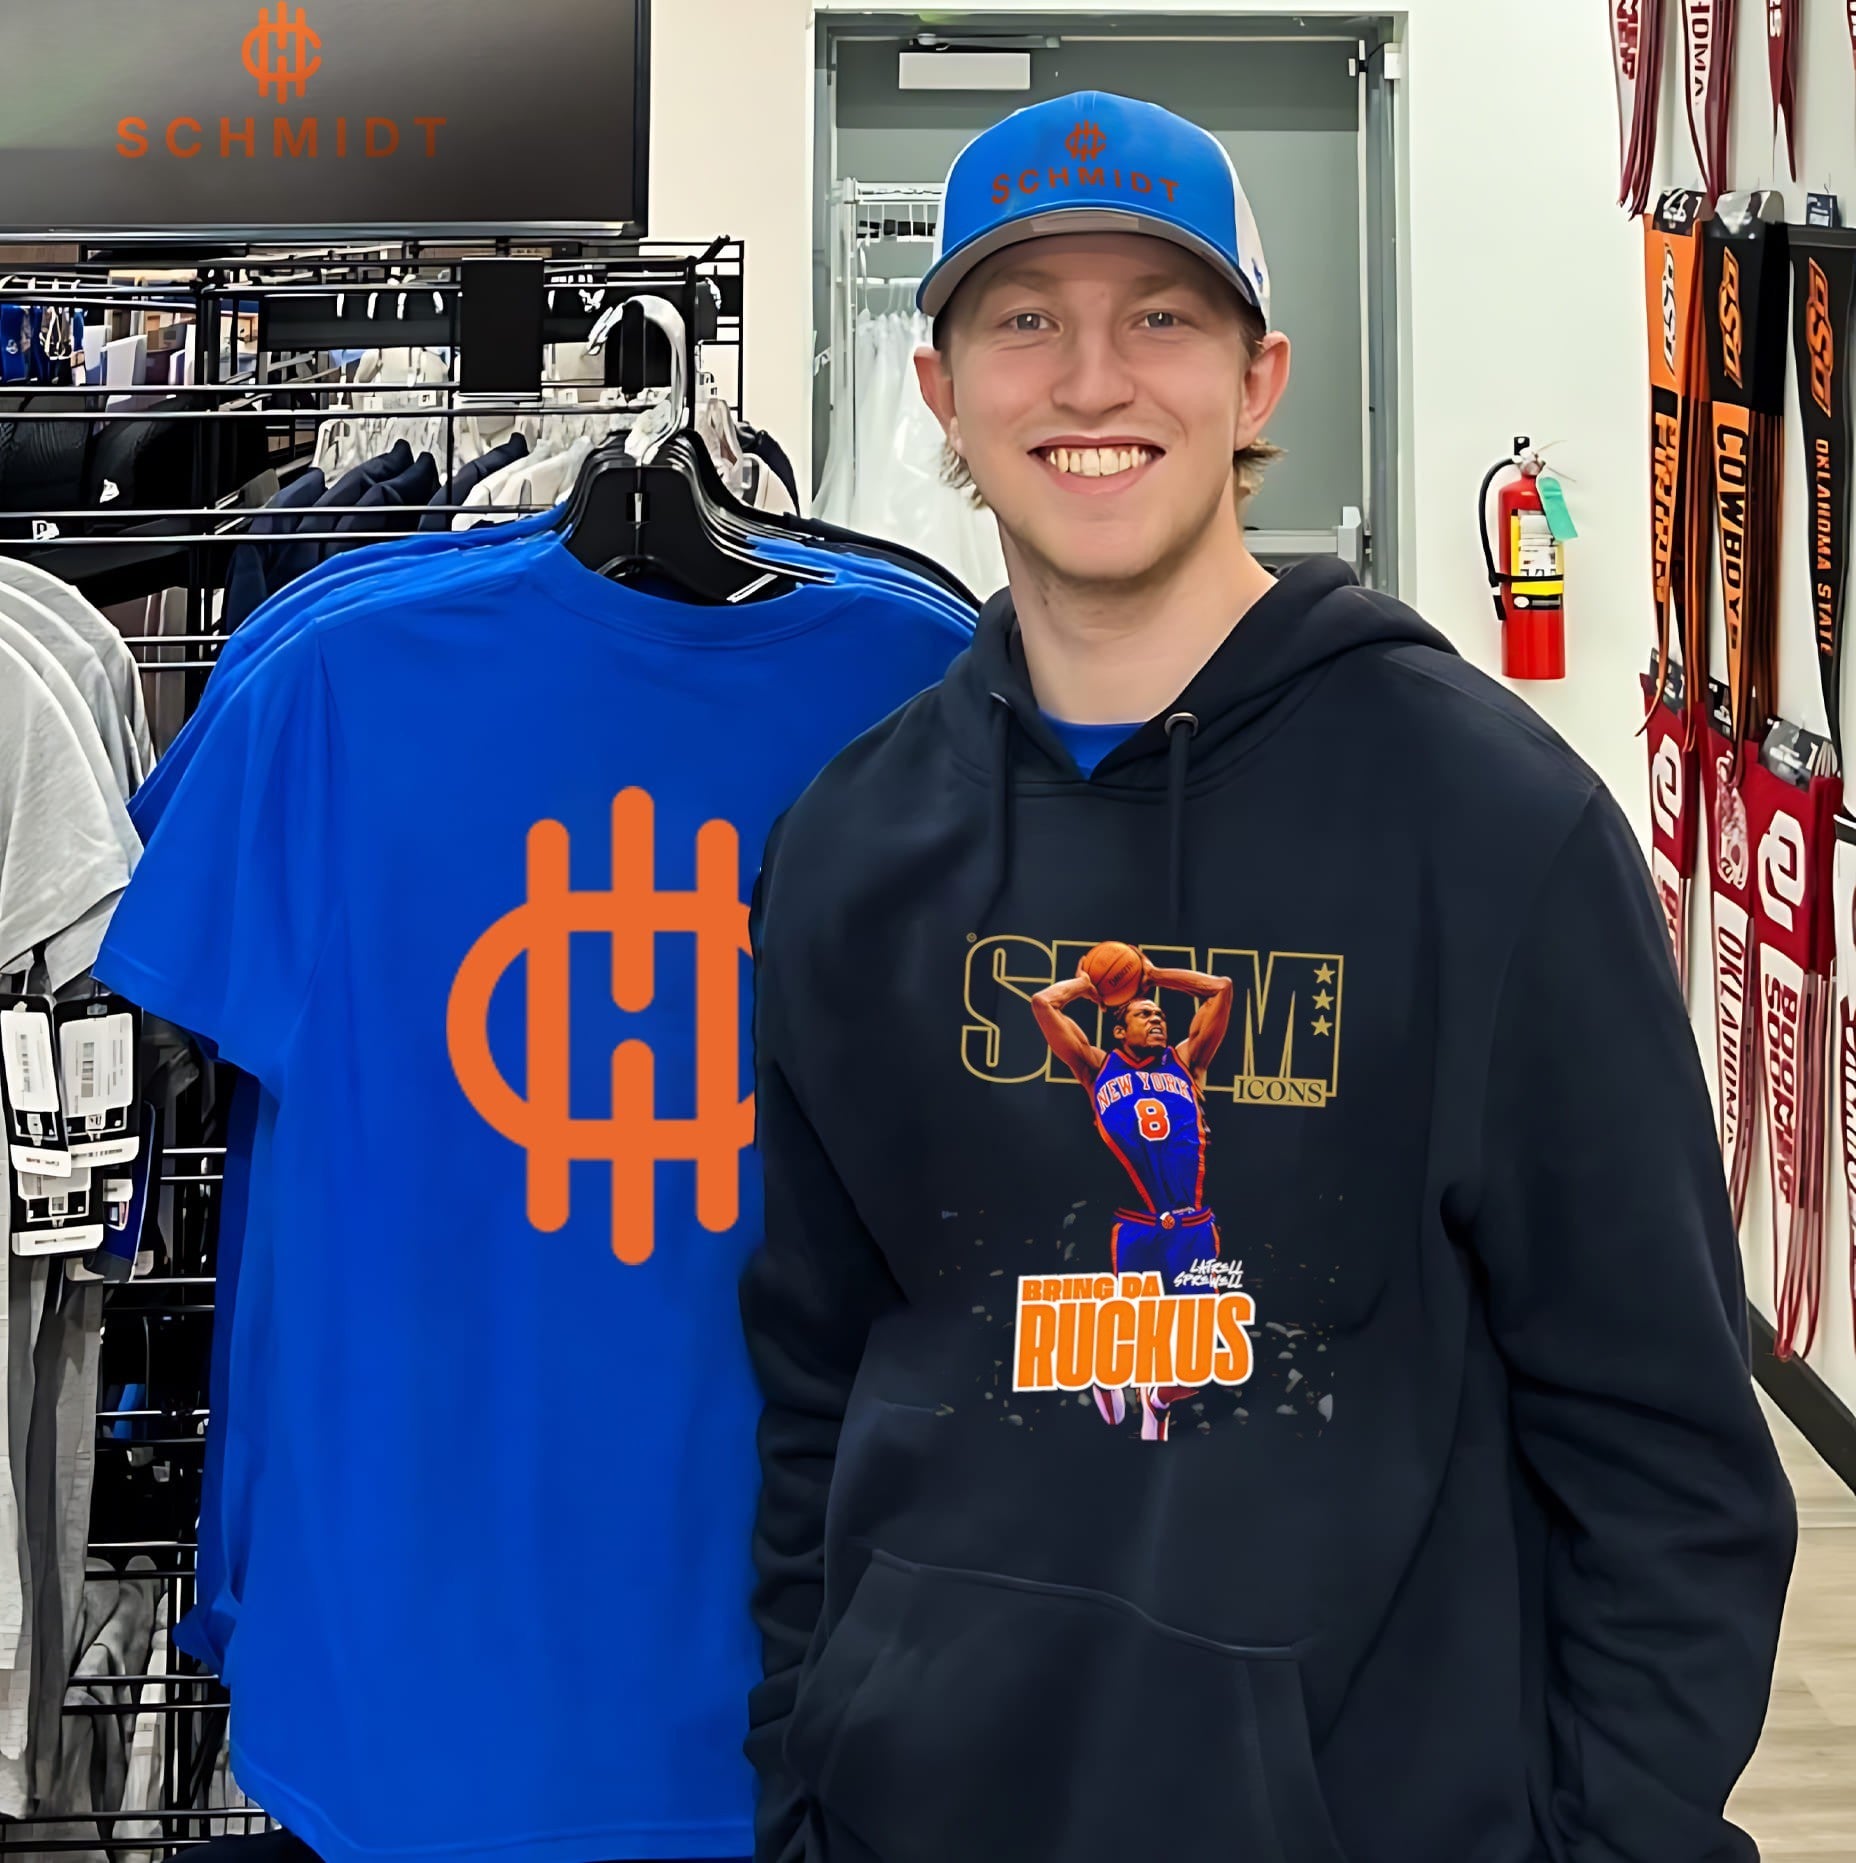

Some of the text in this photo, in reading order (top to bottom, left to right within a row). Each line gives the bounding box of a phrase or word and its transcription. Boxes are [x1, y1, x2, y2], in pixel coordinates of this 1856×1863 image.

[115, 115, 447, 159] SCHMIDT
[991, 166, 1180, 204] SCHMIDT
[1815, 438, 1832, 571] OKLAHOMA
[1718, 925, 1745, 1145] OKLAHOMA
[1096, 1071, 1194, 1116] NEW YORK
[1237, 1079, 1323, 1104] ICONS
[1133, 1097, 1171, 1142] 8
[1019, 1271, 1163, 1303] BRING DA
[1014, 1293, 1256, 1391] RUCKUS
